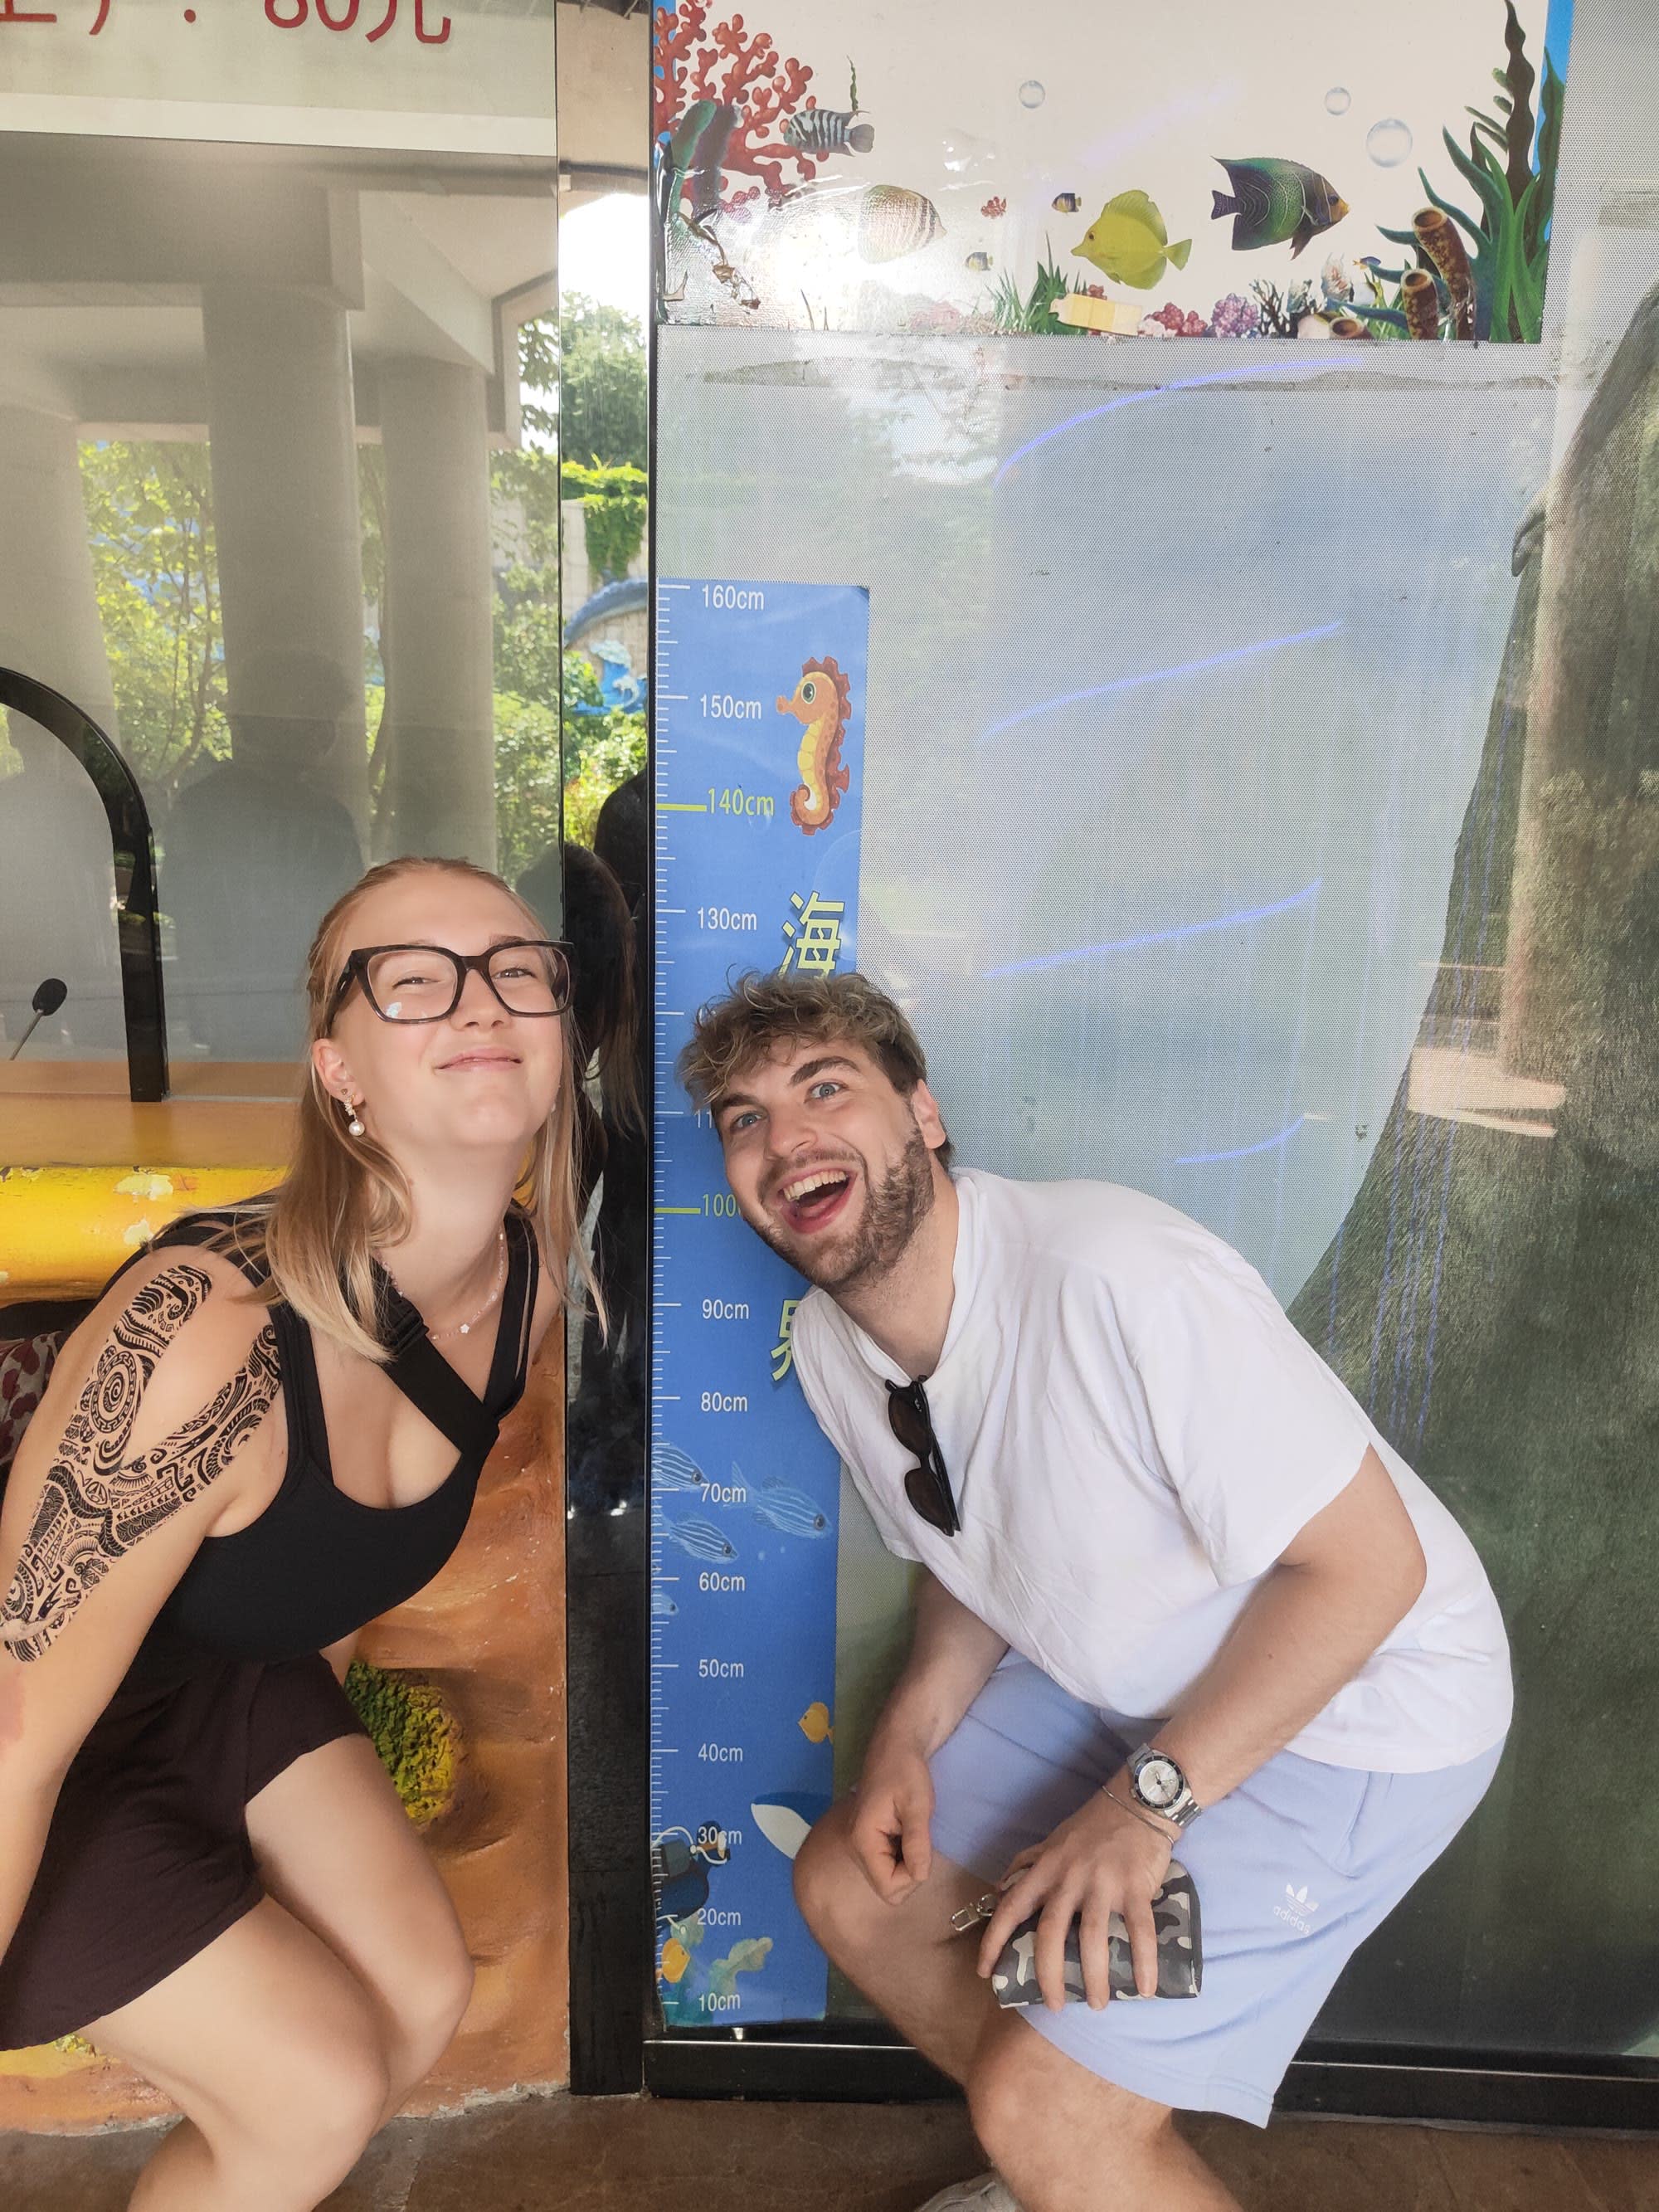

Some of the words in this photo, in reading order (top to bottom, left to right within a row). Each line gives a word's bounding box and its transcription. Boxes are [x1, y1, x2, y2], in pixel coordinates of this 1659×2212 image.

[702, 584, 764, 610] 160cm
[700, 694, 761, 719] 150cm
[708, 787, 774, 816] 140cm
[698, 907, 757, 930] 130cm
[703, 1193, 741, 1217] 100
[702, 1299, 749, 1319] 90cm
[701, 1392, 747, 1411] 80cm
[700, 1483, 747, 1503] 70cm
[698, 1572, 746, 1591] 60cm
[698, 1659, 744, 1678] 50cm
[698, 1743, 743, 1761] 40cm
[698, 1826, 742, 1844] 30cm
[696, 1908, 742, 1926] 20cm
[1272, 1905, 1311, 1935] adidas
[698, 1993, 741, 2011] 10cm
